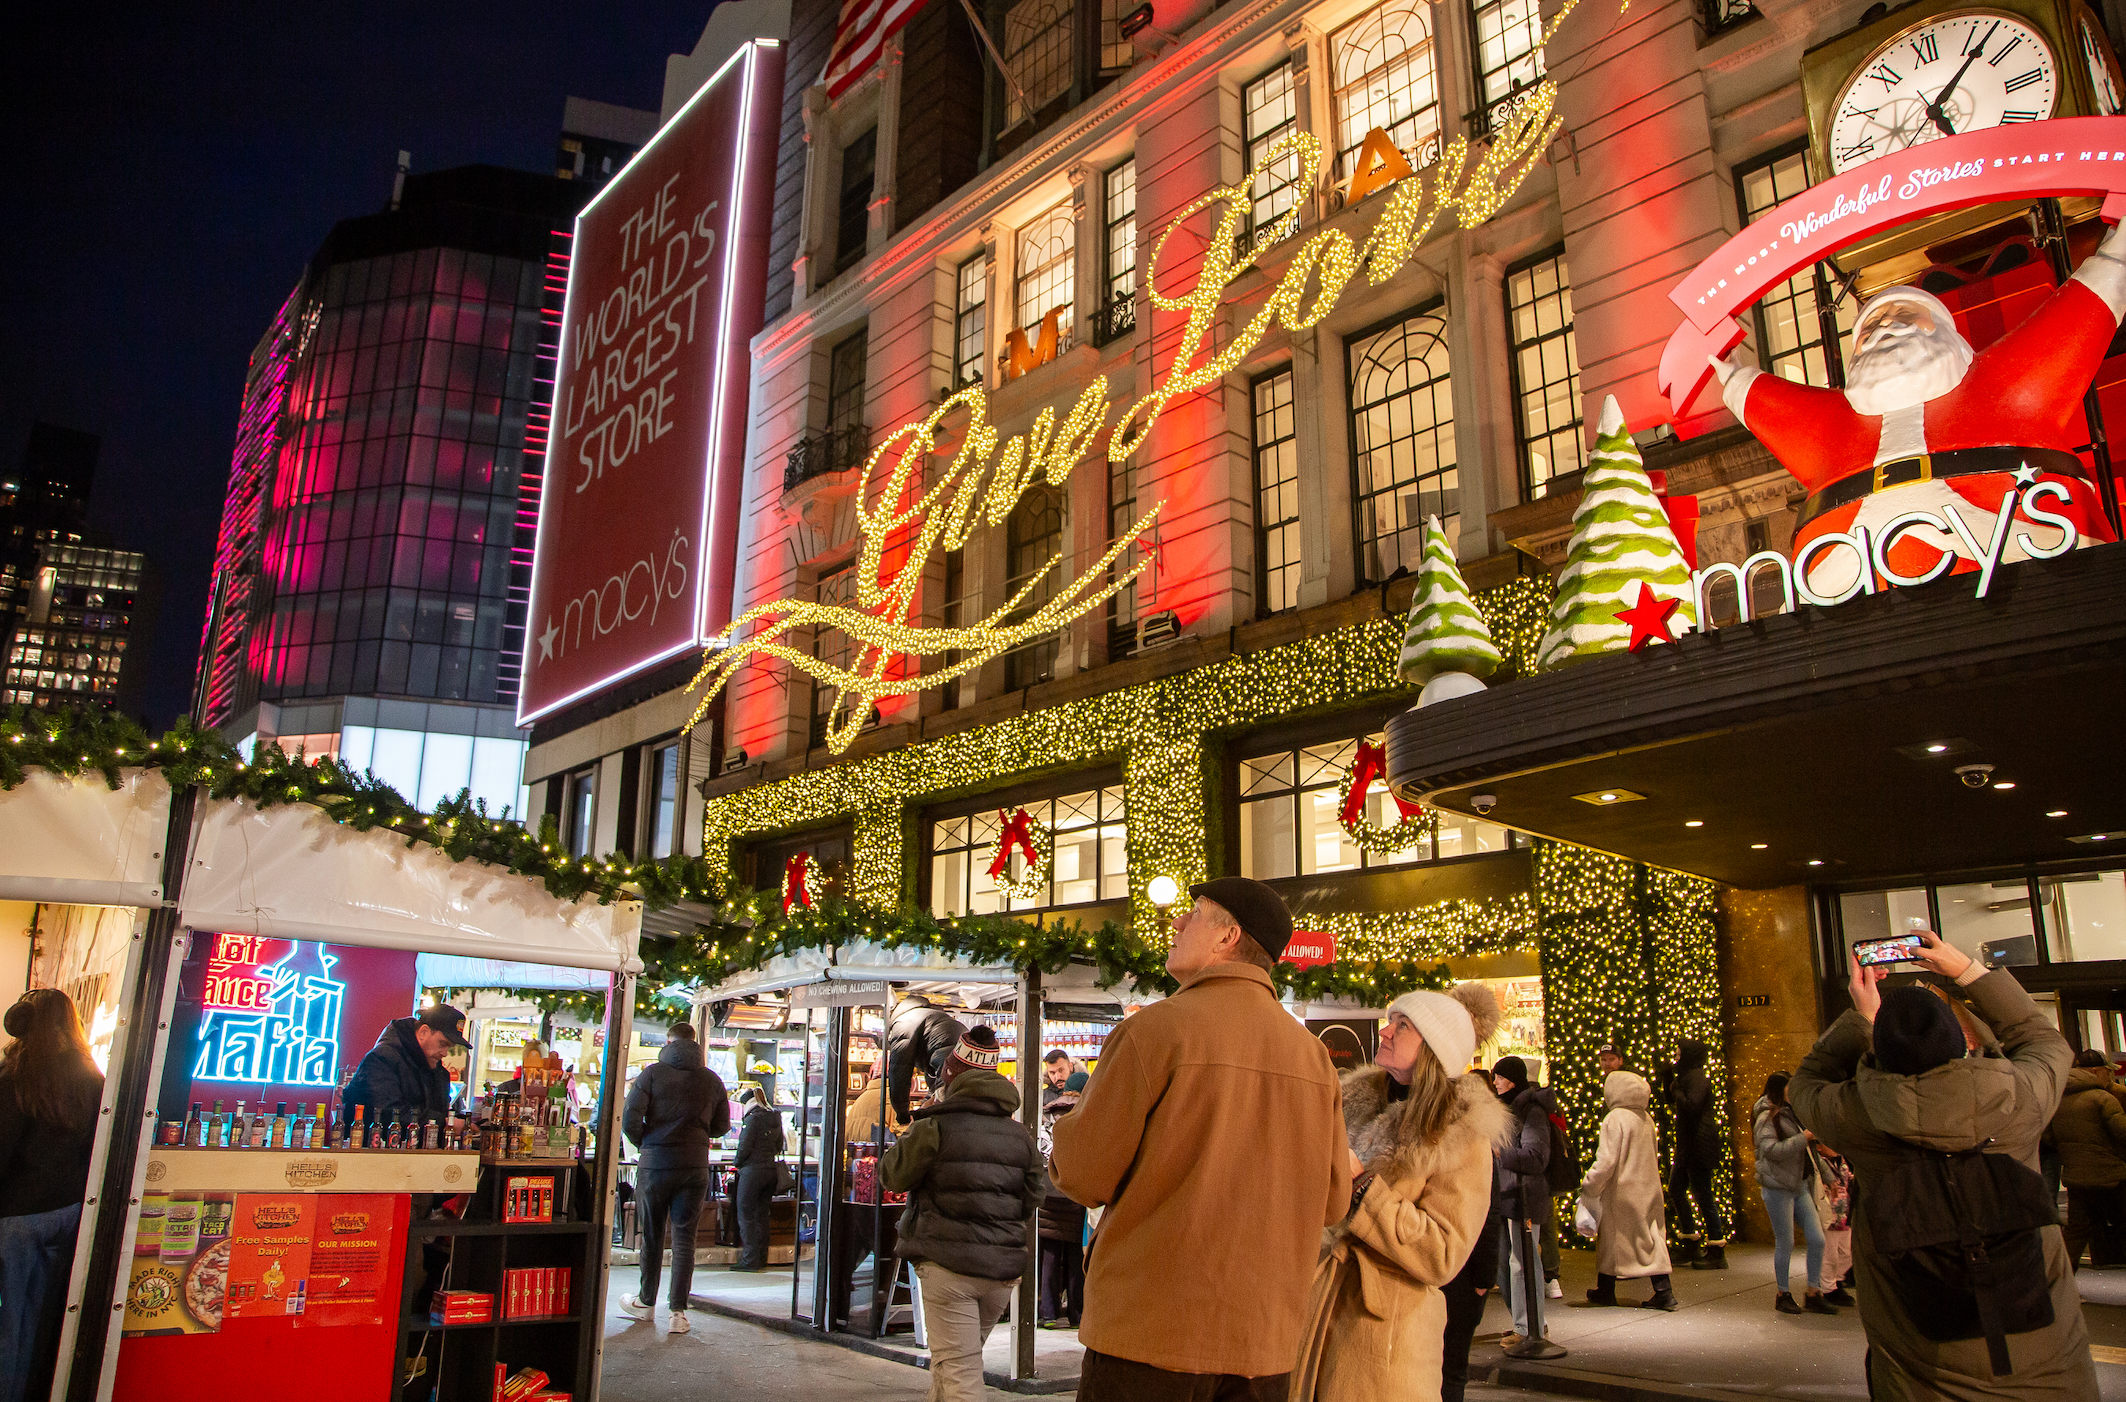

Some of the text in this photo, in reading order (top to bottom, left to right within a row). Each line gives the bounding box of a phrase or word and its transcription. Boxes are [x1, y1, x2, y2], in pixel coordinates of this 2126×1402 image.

[1910, 33, 1939, 70] XII
[619, 172, 681, 272] THE
[1697, 278, 1728, 305] THE
[1734, 240, 1778, 275] MOST
[1779, 173, 1893, 244] Wonderful
[1897, 157, 1986, 201] Stories
[1993, 151, 2065, 168] START
[575, 200, 719, 371] WORLD'S
[563, 274, 708, 438] LARGEST
[576, 370, 678, 494] STORE
[1692, 468, 2079, 634] macy's
[559, 527, 690, 649] macy's
[1287, 944, 1324, 959] ALLOWED!
[808, 980, 884, 997] NO CHEWING ALLOWED!
[1740, 996, 1766, 1006] 1317
[285, 1170, 337, 1178] KITCHEN
[291, 1163, 332, 1171] HELL'S
[252, 1213, 301, 1221] KITCHEN
[202, 1227, 224, 1235] CAT
[235, 1236, 260, 1245] Free
[263, 1235, 310, 1246] Samples
[257, 1247, 289, 1258] Daily!
[318, 1240, 378, 1248] OUR MISSION
[129, 1267, 155, 1290] MADE
[126, 1296, 178, 1319] HERE IN NYC
